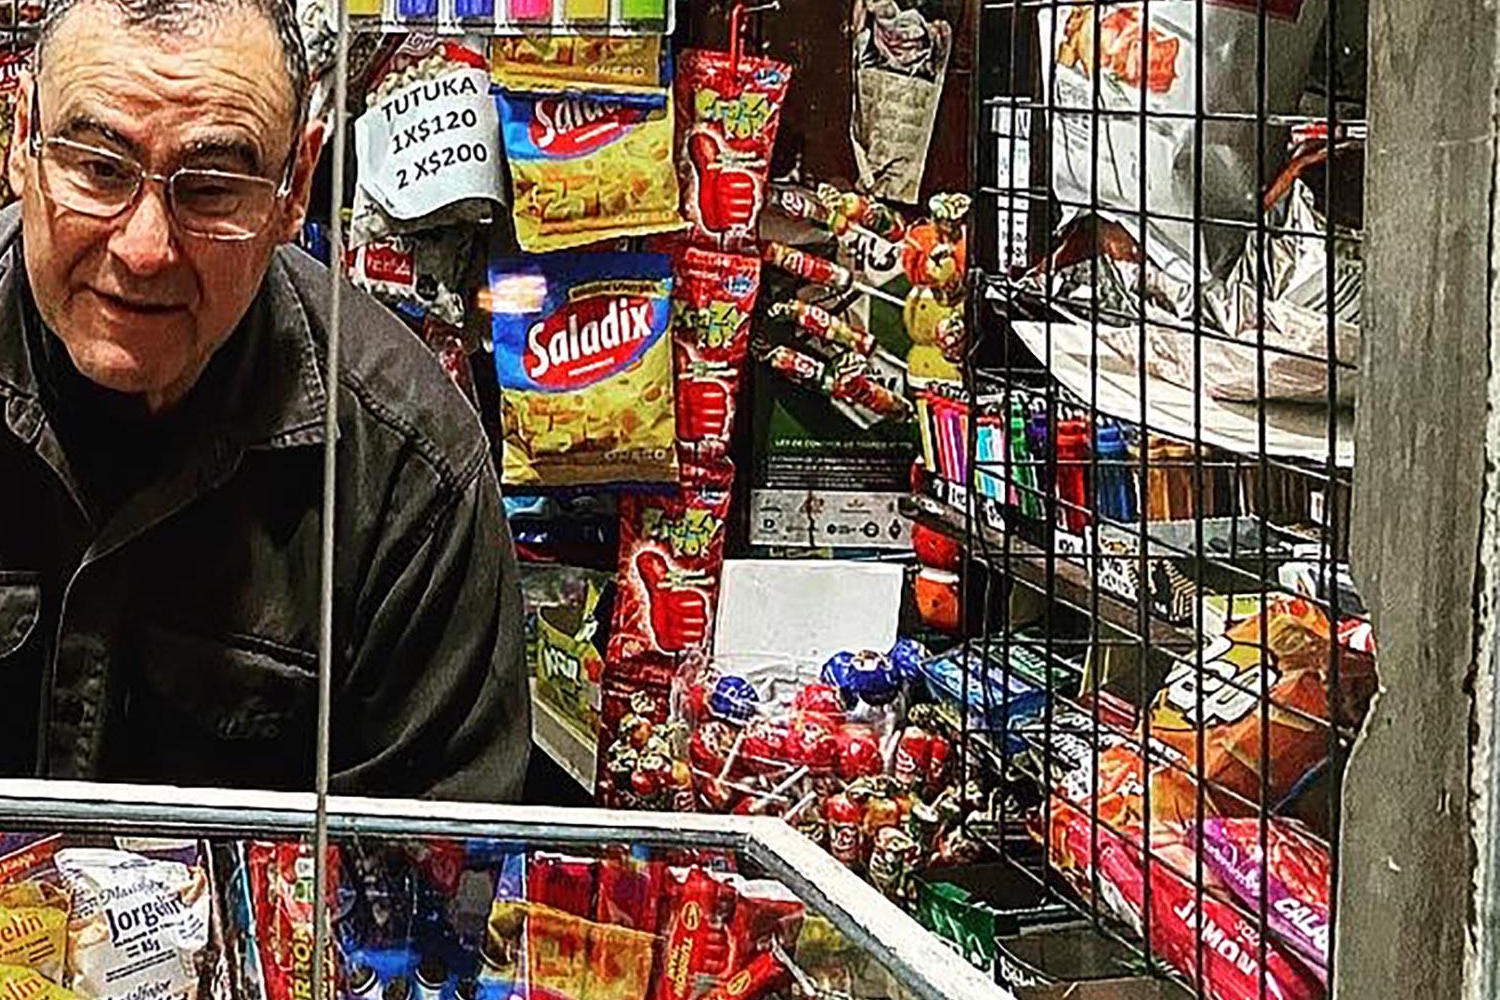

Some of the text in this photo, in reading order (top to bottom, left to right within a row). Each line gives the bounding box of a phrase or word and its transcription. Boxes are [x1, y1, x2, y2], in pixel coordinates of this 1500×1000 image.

[381, 75, 478, 122] TUTUKA
[391, 108, 477, 155] 1X$120
[396, 143, 488, 190] 2 X$200
[530, 297, 652, 378] Saladix
